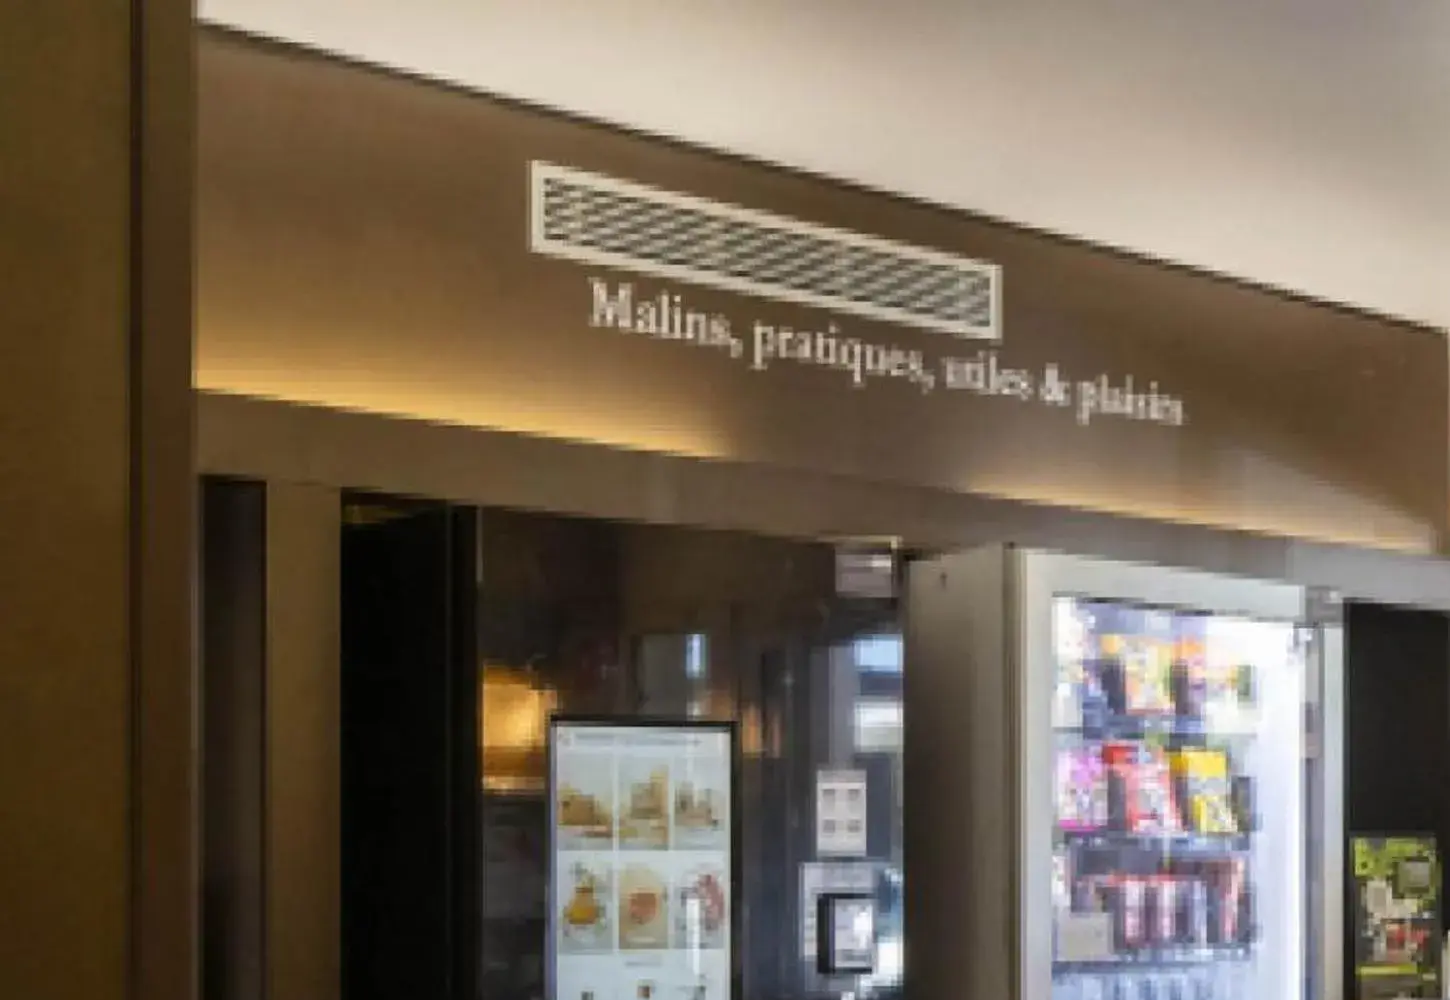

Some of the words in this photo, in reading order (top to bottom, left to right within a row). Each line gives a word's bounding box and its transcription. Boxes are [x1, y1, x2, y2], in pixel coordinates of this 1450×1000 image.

[590, 278, 742, 358] Malins,
[751, 322, 934, 391] pratiques,
[1040, 362, 1070, 407] &
